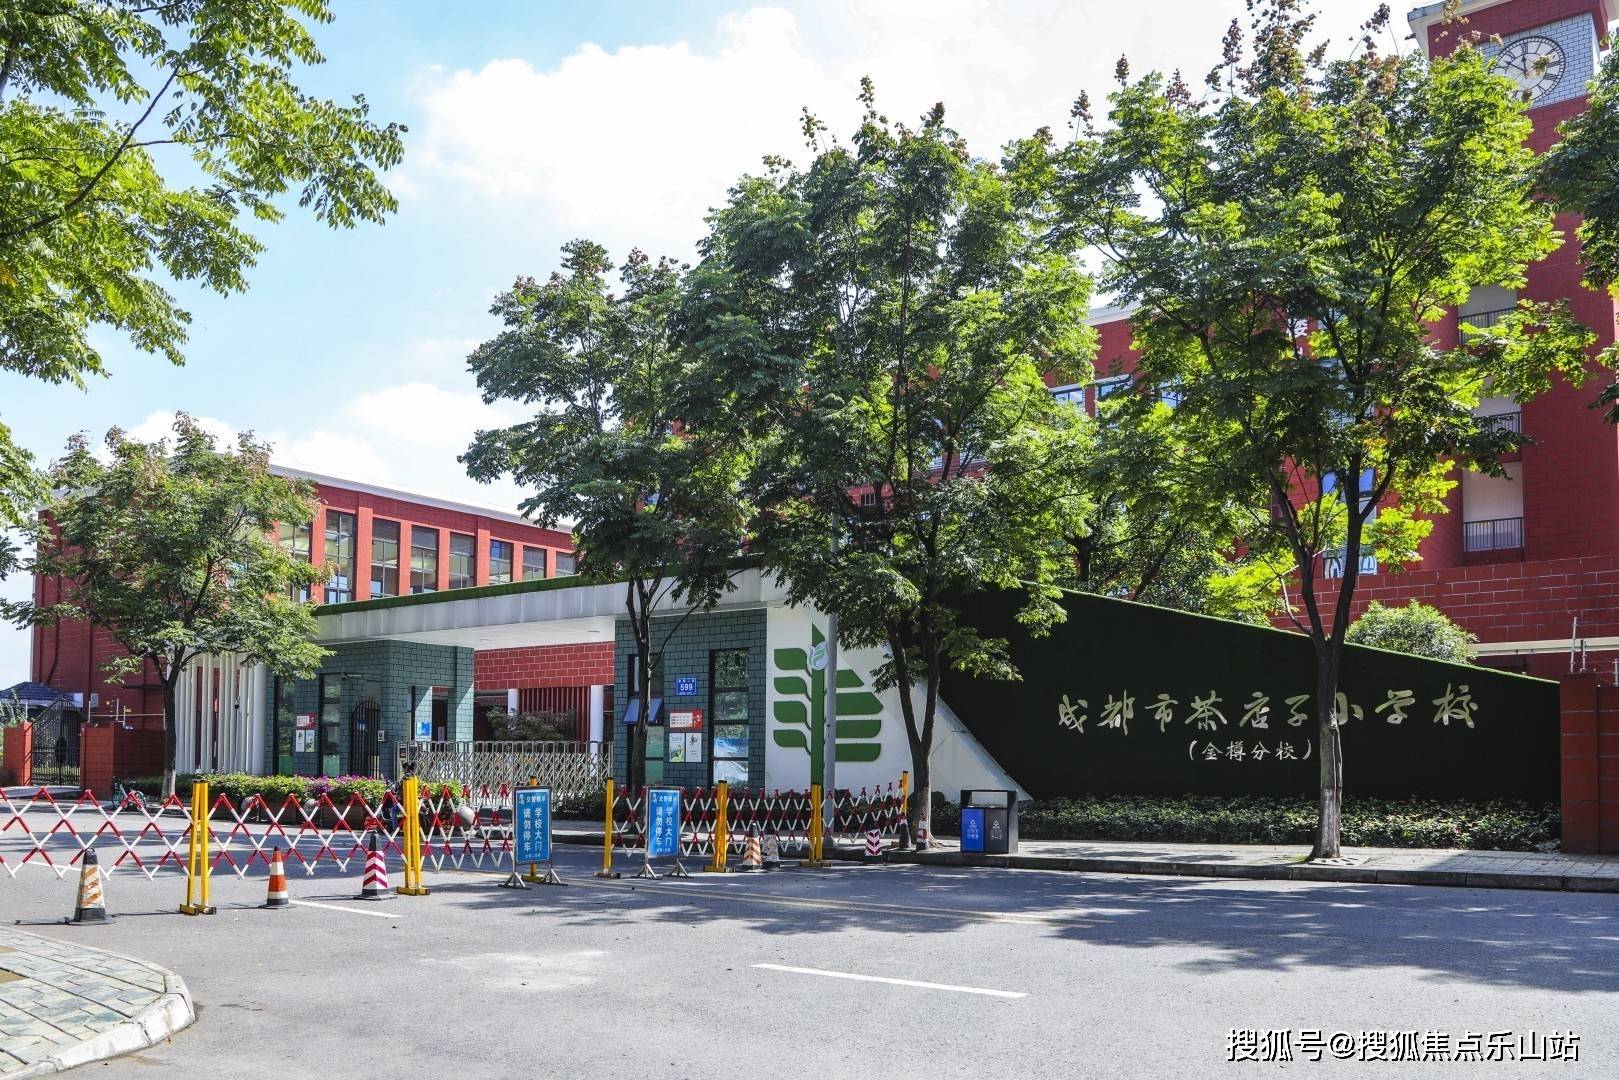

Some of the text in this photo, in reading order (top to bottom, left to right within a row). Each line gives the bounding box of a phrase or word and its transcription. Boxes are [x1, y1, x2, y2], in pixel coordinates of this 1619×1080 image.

[680, 683, 693, 691] 599
[1058, 683, 1479, 735] 成都市茶店子小学校
[1188, 739, 1312, 761] （金樽分校）
[523, 807, 531, 852] 请勿停车
[535, 807, 543, 852] 学校大门
[655, 806, 663, 847] 请勿停车
